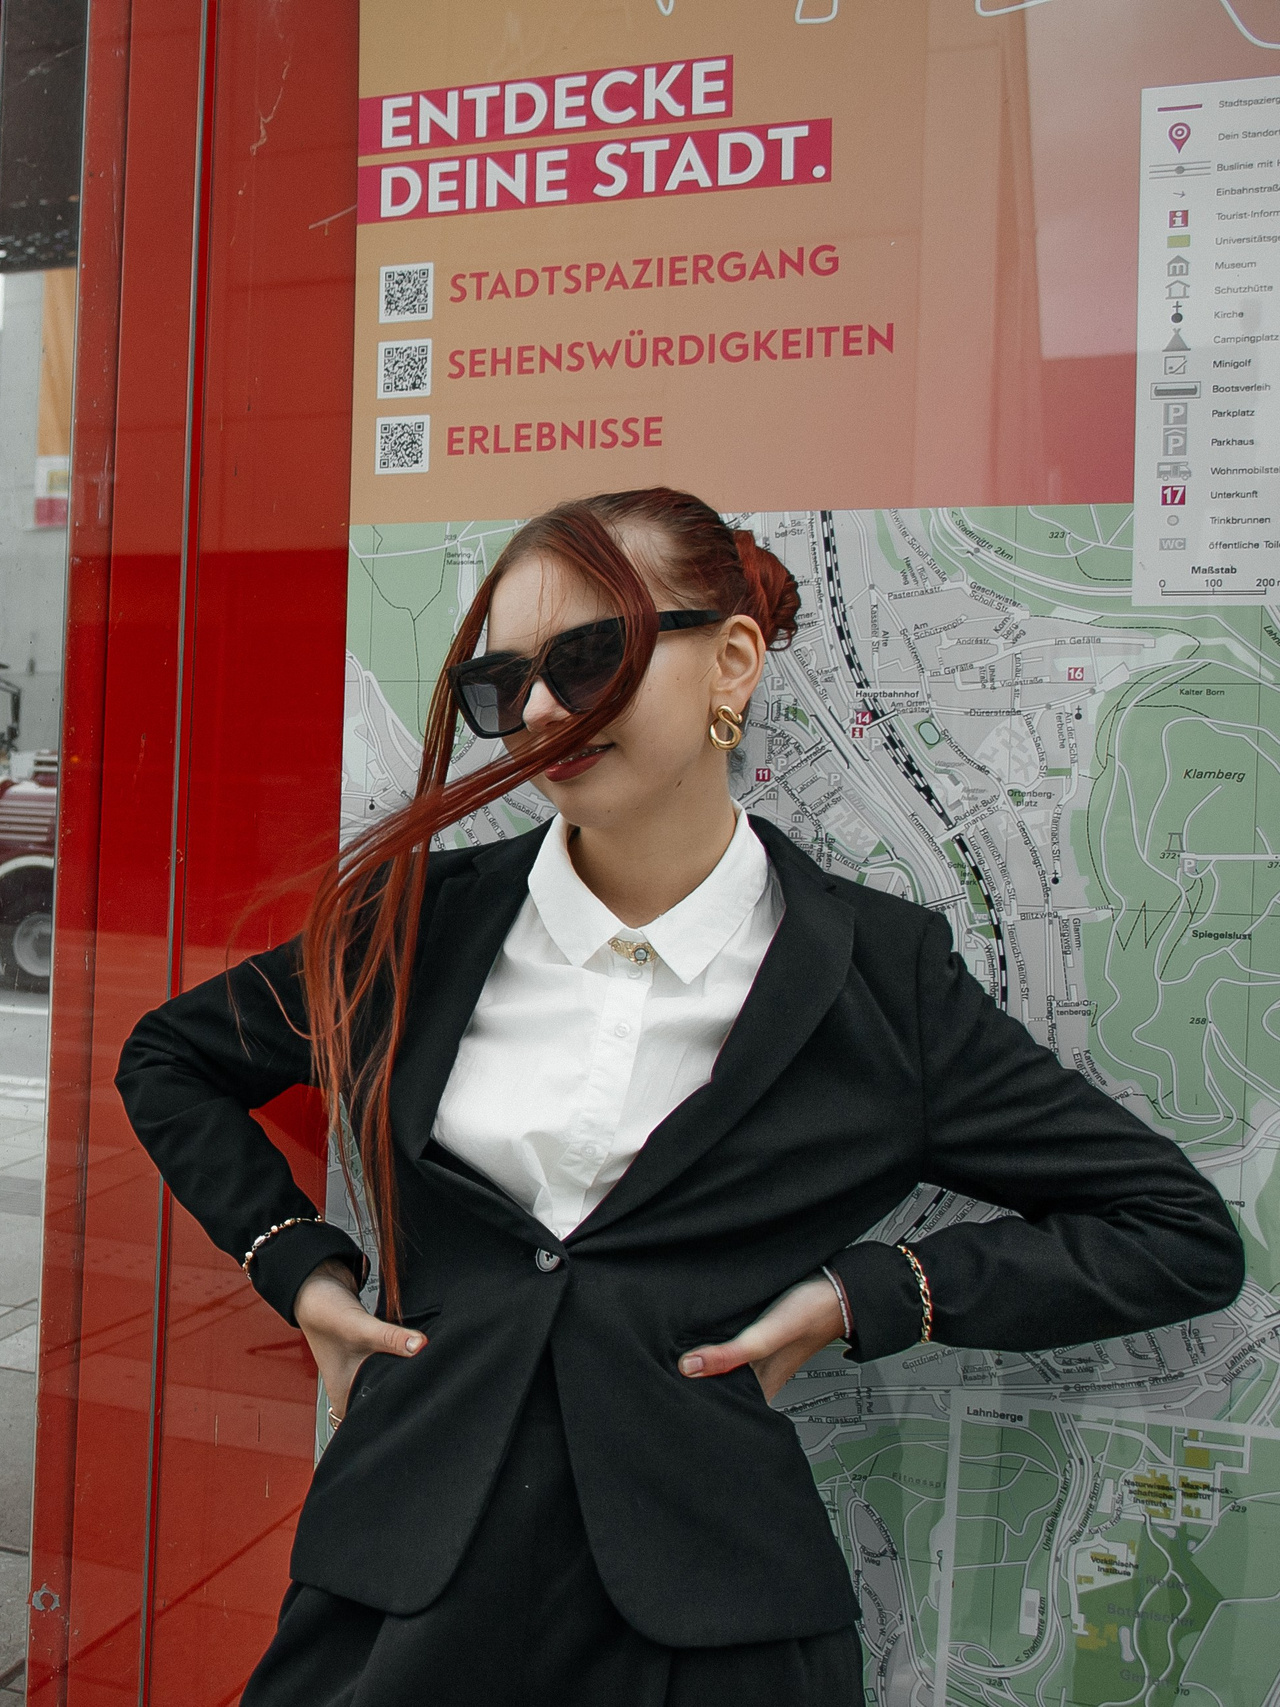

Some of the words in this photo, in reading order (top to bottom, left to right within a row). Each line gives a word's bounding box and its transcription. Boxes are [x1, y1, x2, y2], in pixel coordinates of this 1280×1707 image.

[381, 58, 728, 149] ENTDECKE
[1218, 132, 1239, 141] Dein
[380, 148, 569, 219] DEINE
[593, 125, 826, 197] STADT.
[1216, 162, 1254, 172] Buslinie
[1257, 160, 1273, 168] mit
[1214, 261, 1257, 270] Museum
[449, 244, 840, 304] STADTSPAZIERGANG
[1214, 284, 1274, 295] Schutzhütte
[1213, 310, 1244, 319] Kirche
[1213, 333, 1280, 344] Campingplatz
[447, 322, 895, 380] SEHENSWÜRDIGKEITEN
[1212, 359, 1252, 370] Minigolf
[1212, 383, 1271, 394] Bootsverleih
[1211, 409, 1255, 419] Parkplatz
[447, 416, 664, 456] ERLEBNISSE
[1210, 438, 1255, 447] Parkhaus
[1162, 486, 1185, 505] 17
[1210, 490, 1259, 500] Unterkunft
[1209, 516, 1271, 525] Trinkbrunnen
[955, 519, 994, 550] Stadtmitte
[994, 546, 1014, 561] 2km
[1049, 531, 1066, 539] 323
[1161, 540, 1185, 549] WC
[1208, 540, 1260, 550] öffentliche
[1191, 565, 1238, 575] Maßstab
[900, 569, 910, 586] Weg
[1205, 579, 1223, 588] 100
[1256, 578, 1275, 588] 200
[888, 585, 943, 600] Pasternakstr.
[969, 581, 1023, 609] Geschwister-
[969, 590, 1009, 613] Scholl-Str.
[913, 622, 928, 631] Am
[1011, 629, 1026, 645] weg
[1055, 638, 1067, 646] Im
[1069, 636, 1102, 645] Gefälle
[930, 669, 941, 677] Im
[944, 663, 974, 675] Gefälle
[1070, 669, 1083, 680] 16
[856, 690, 920, 700] Hauptbahnhof
[1179, 688, 1203, 696] Kalter
[1206, 688, 1225, 696] Born
[856, 711, 871, 724] 14
[969, 708, 1022, 717] Dürerstraße
[1023, 713, 1048, 780] Hans-Sachs-Str.
[757, 770, 770, 780] 11
[1183, 768, 1246, 782] Klamberg
[1007, 788, 1056, 798] Ortenberg-
[954, 794, 1000, 822] Rudolf-Bult-
[1016, 799, 1038, 808] platz
[964, 805, 1003, 829] mann-Str.
[908, 811, 946, 861] Krummbogen
[1016, 820, 1052, 898] Georg-Voigt-Straße
[1160, 852, 1176, 860] 372
[979, 827, 1017, 903] Heinrich-Heine-Str.
[968, 835, 1004, 913] Ludwig-Juppe-Weg
[1020, 911, 1058, 921] Blitzweg
[1061, 918, 1071, 956] bergweg
[1072, 917, 1081, 951] Glamm-
[1191, 929, 1252, 941] Spiegelslust
[1007, 923, 1030, 1003] Heinrich-Heine-Str.
[1189, 1017, 1207, 1025] 258
[1082, 1049, 1108, 1087] Katharina-
[807, 1369, 849, 1378] Körnerstr.
[807, 1416, 822, 1424] Am
[966, 1406, 1024, 1422] Lahnberge
[1229, 1504, 1247, 1513] 329
[1042, 1497, 1064, 1552] Uni-Klinikum
[1069, 1502, 1095, 1546] Stadtmitte
